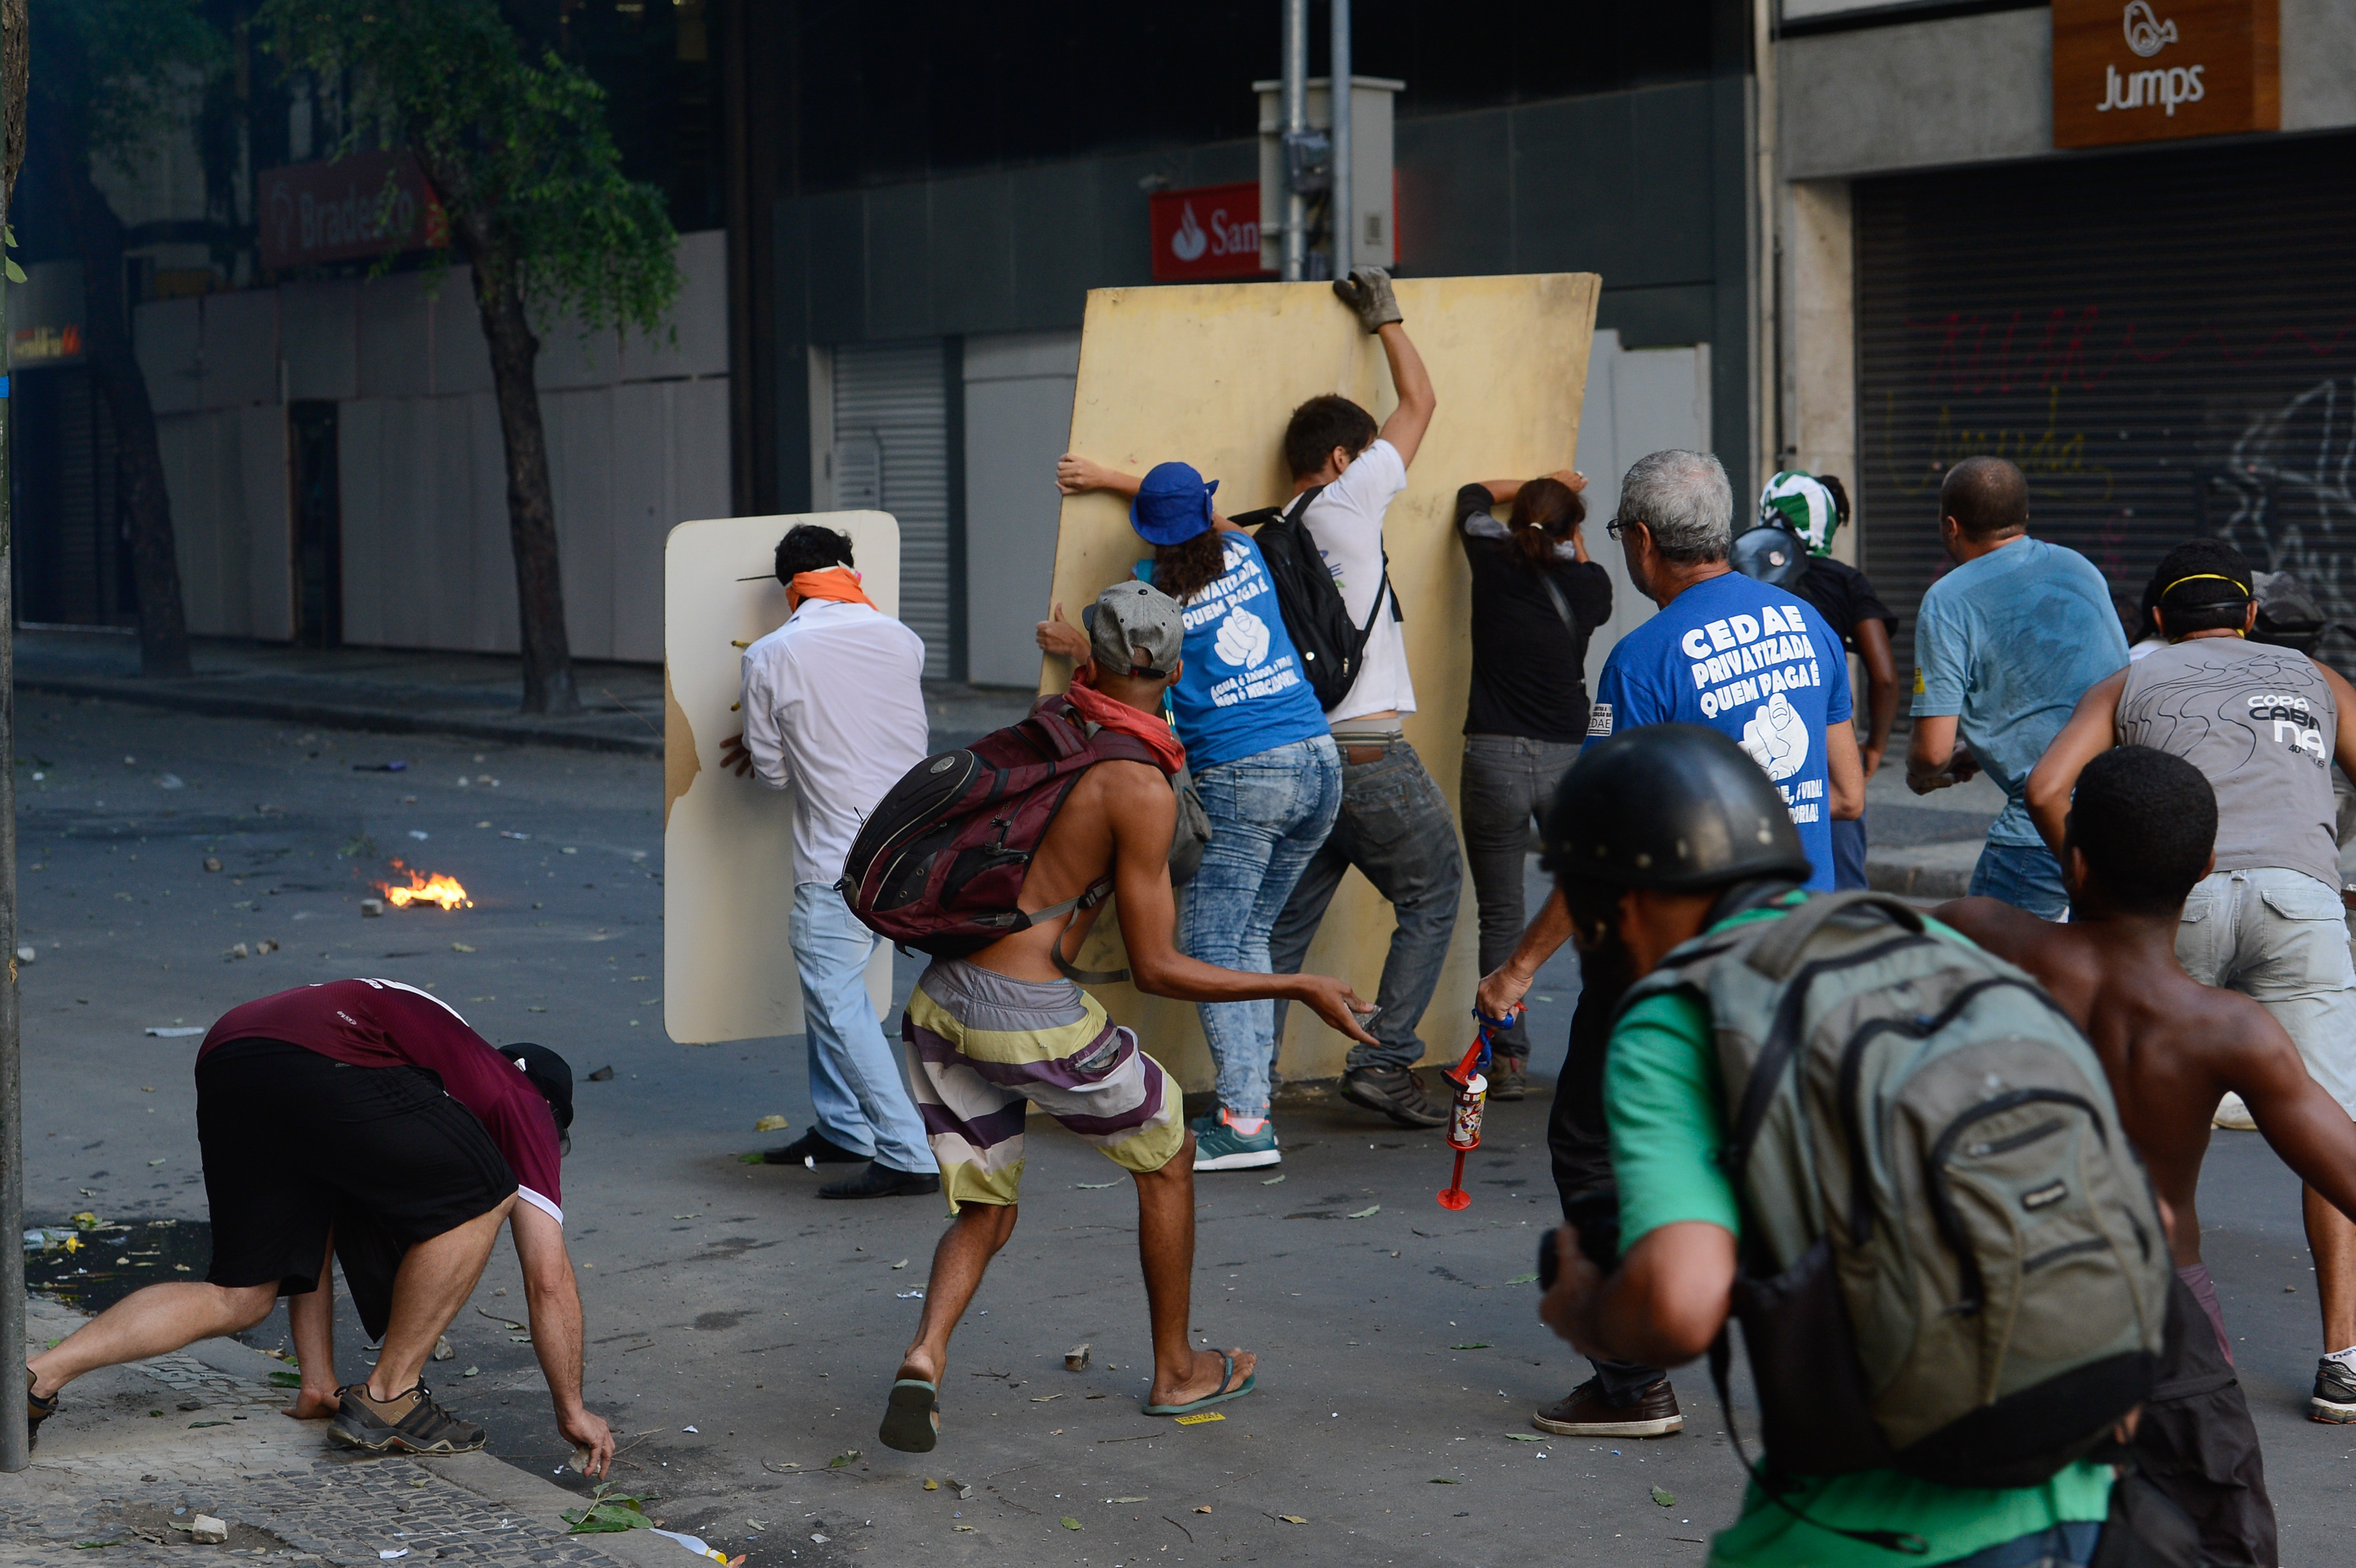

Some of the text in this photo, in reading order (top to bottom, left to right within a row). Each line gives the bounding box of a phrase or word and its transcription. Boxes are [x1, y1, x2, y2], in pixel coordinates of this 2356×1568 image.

[2096, 64, 2205, 117] Jumps
[1182, 599, 1227, 630] QUEM
[1682, 605, 1807, 659] CEDAE
[1691, 634, 1816, 690] PRIVATIZADA
[1700, 658, 1821, 719] QUEM PAGA É
[2247, 694, 2310, 711] COPA
